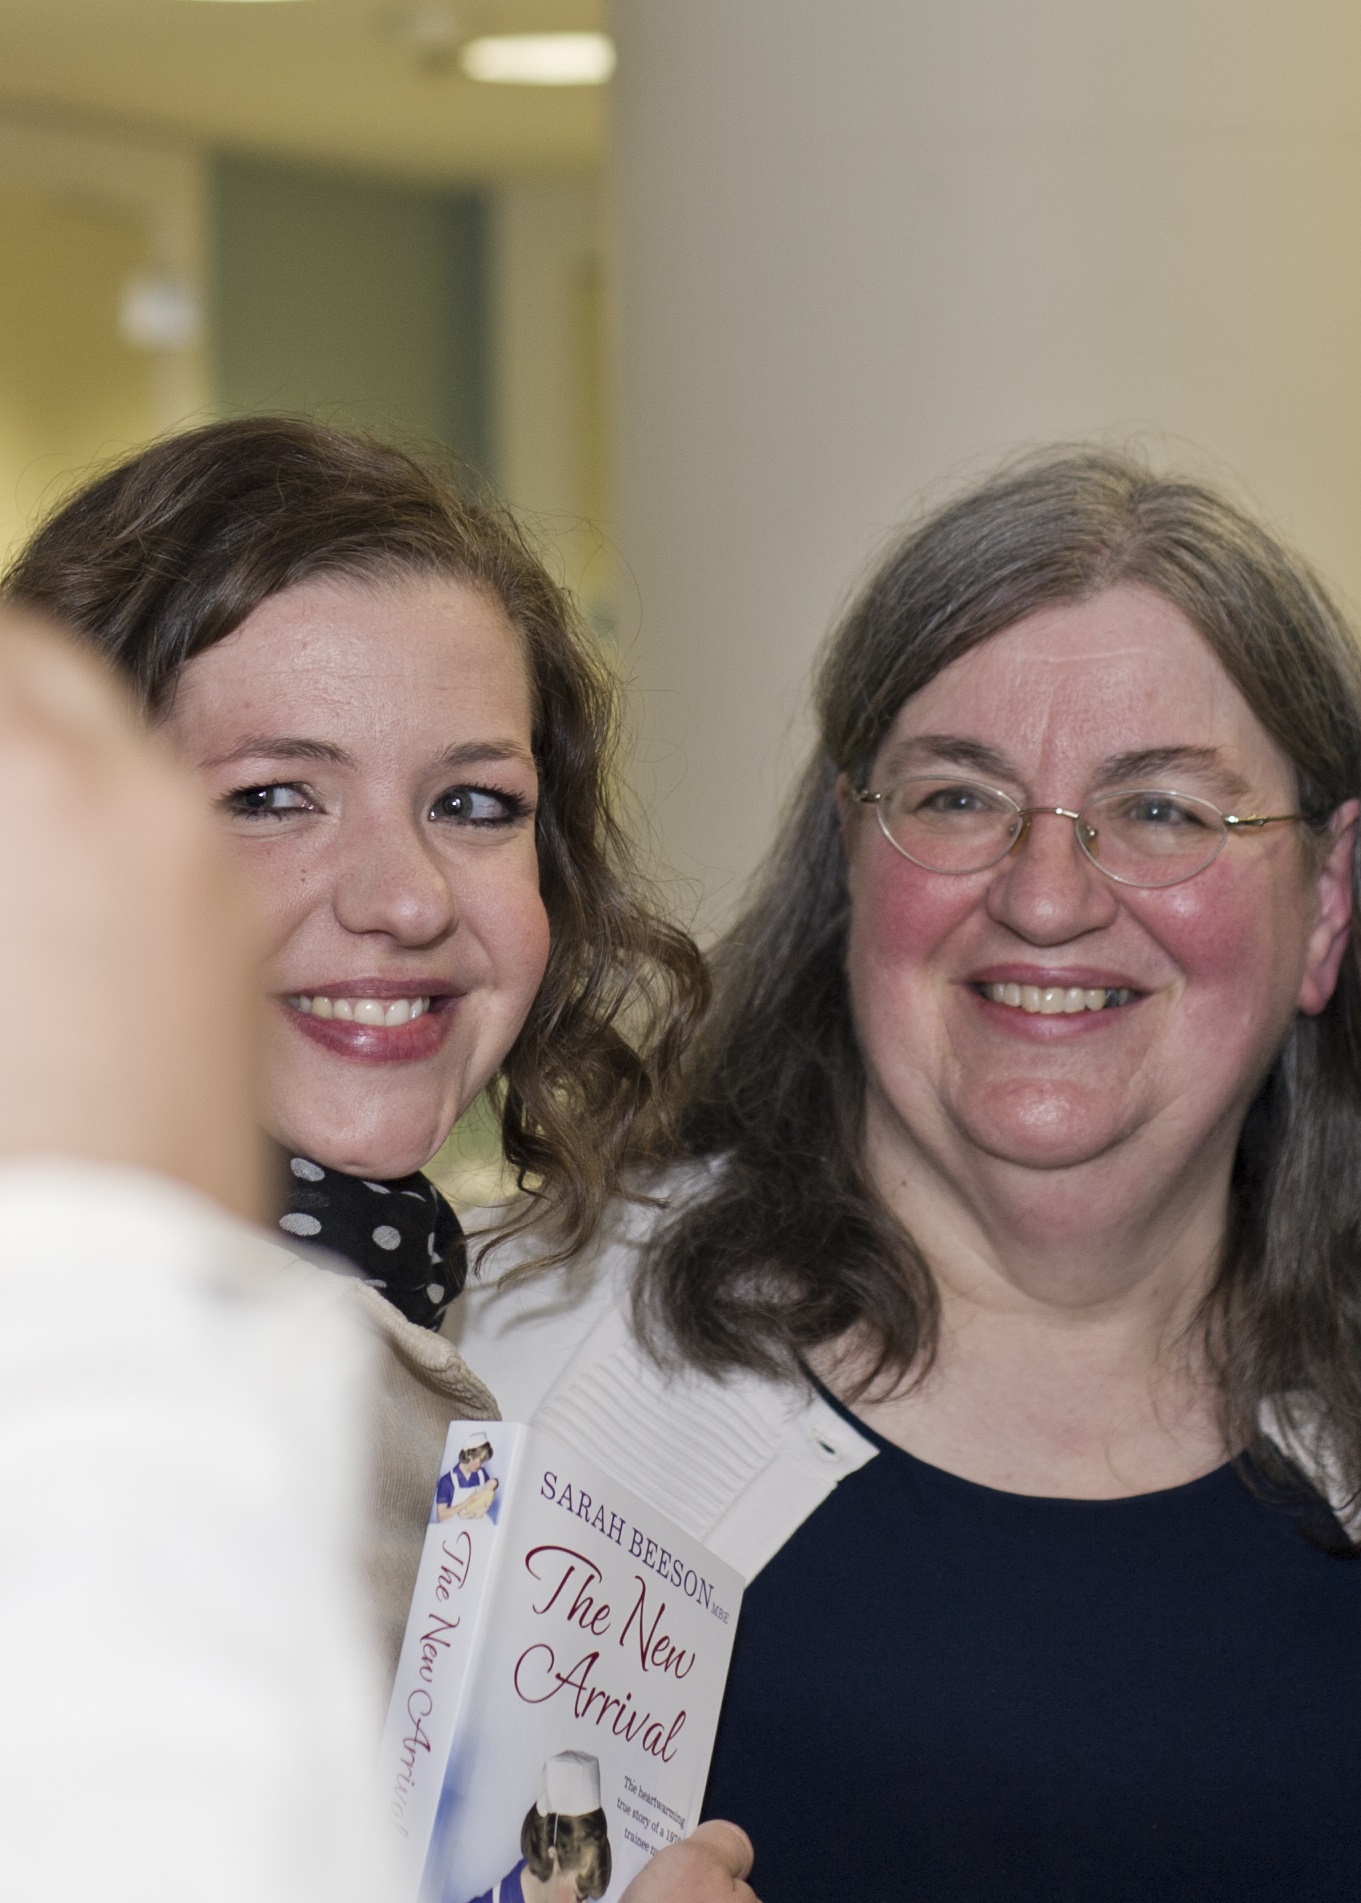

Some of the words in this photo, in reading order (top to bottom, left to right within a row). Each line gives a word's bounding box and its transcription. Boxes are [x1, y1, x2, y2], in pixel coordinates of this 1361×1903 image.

[436, 1531, 472, 1602] The
[540, 1471, 626, 1546] SARAH
[628, 1527, 715, 1610] BEESON
[711, 1602, 730, 1624] MBE
[525, 1545, 611, 1636] The
[619, 1575, 696, 1679] New
[419, 1613, 461, 1683] New
[514, 1643, 686, 1763] Arrival
[390, 1689, 433, 1838] Arrival
[616, 1797, 631, 1816] true
[632, 1809, 651, 1830] story
[651, 1821, 660, 1834] of
[624, 1775, 637, 1794] The
[638, 1785, 685, 1829] heartwarming
[624, 1827, 649, 1852] trainee
